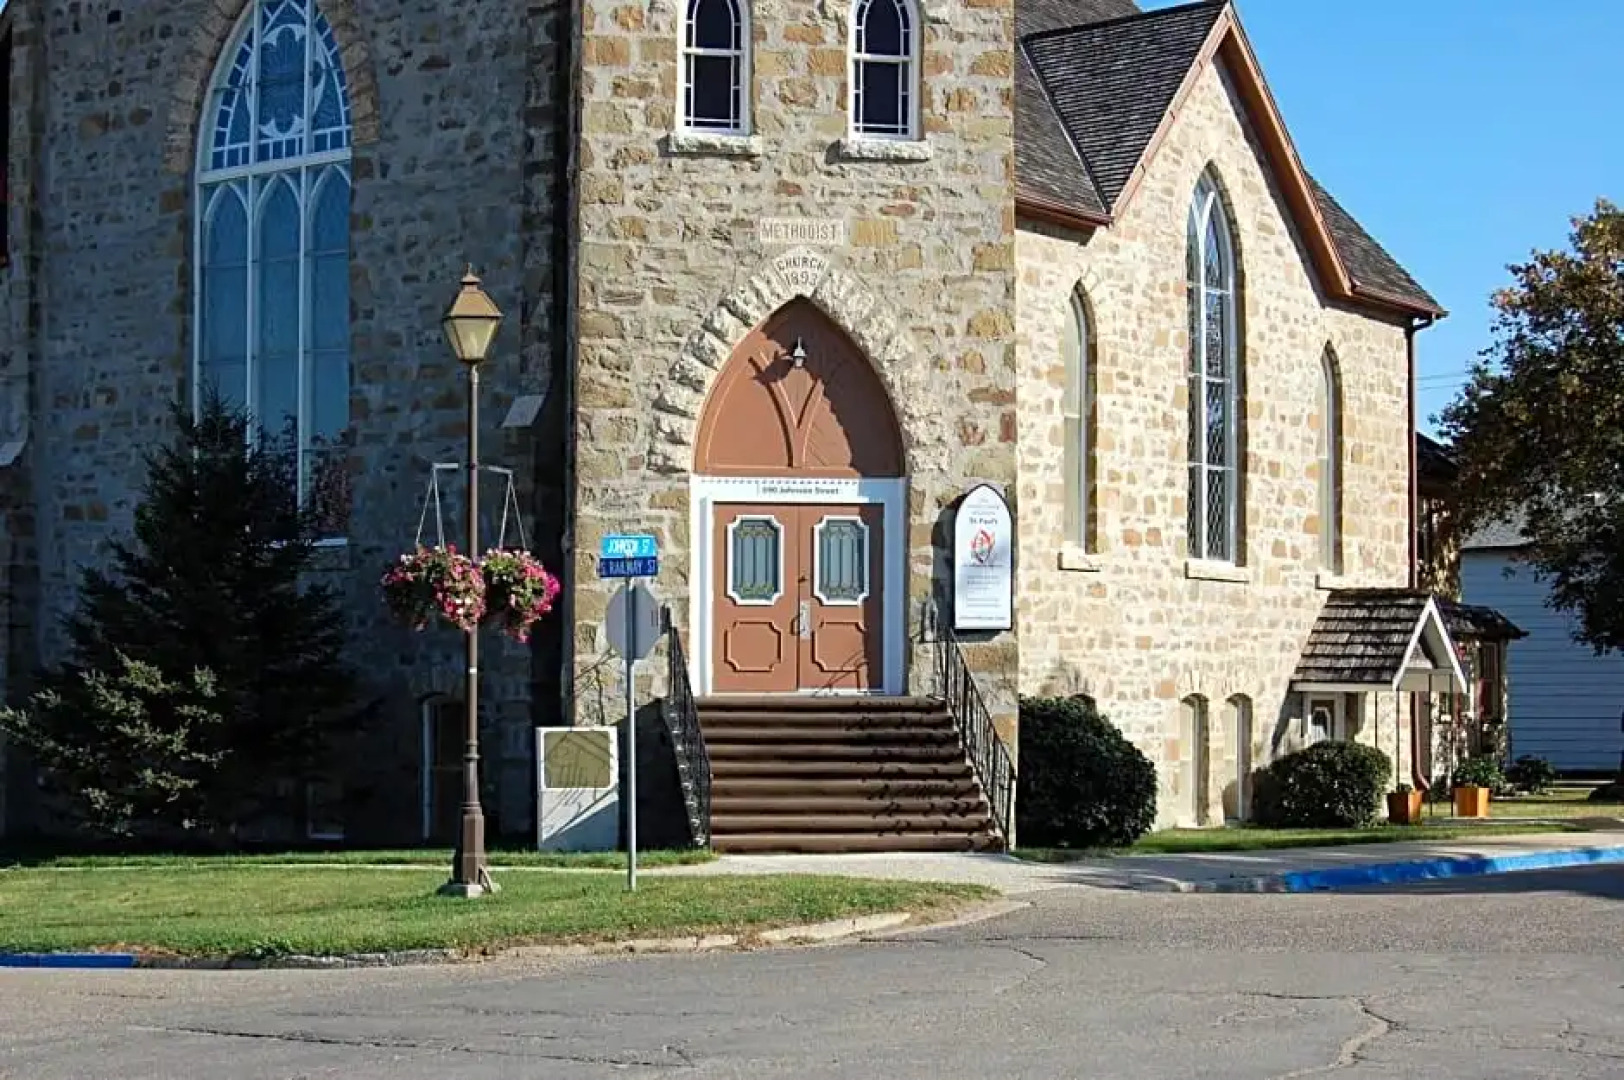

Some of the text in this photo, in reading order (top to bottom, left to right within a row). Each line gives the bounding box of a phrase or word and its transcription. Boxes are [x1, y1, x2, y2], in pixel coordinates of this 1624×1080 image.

[761, 222, 837, 240] METHODIST
[777, 256, 826, 271] CHURCH
[815, 486, 840, 495] Street
[609, 559, 642, 575] RAILWAY
